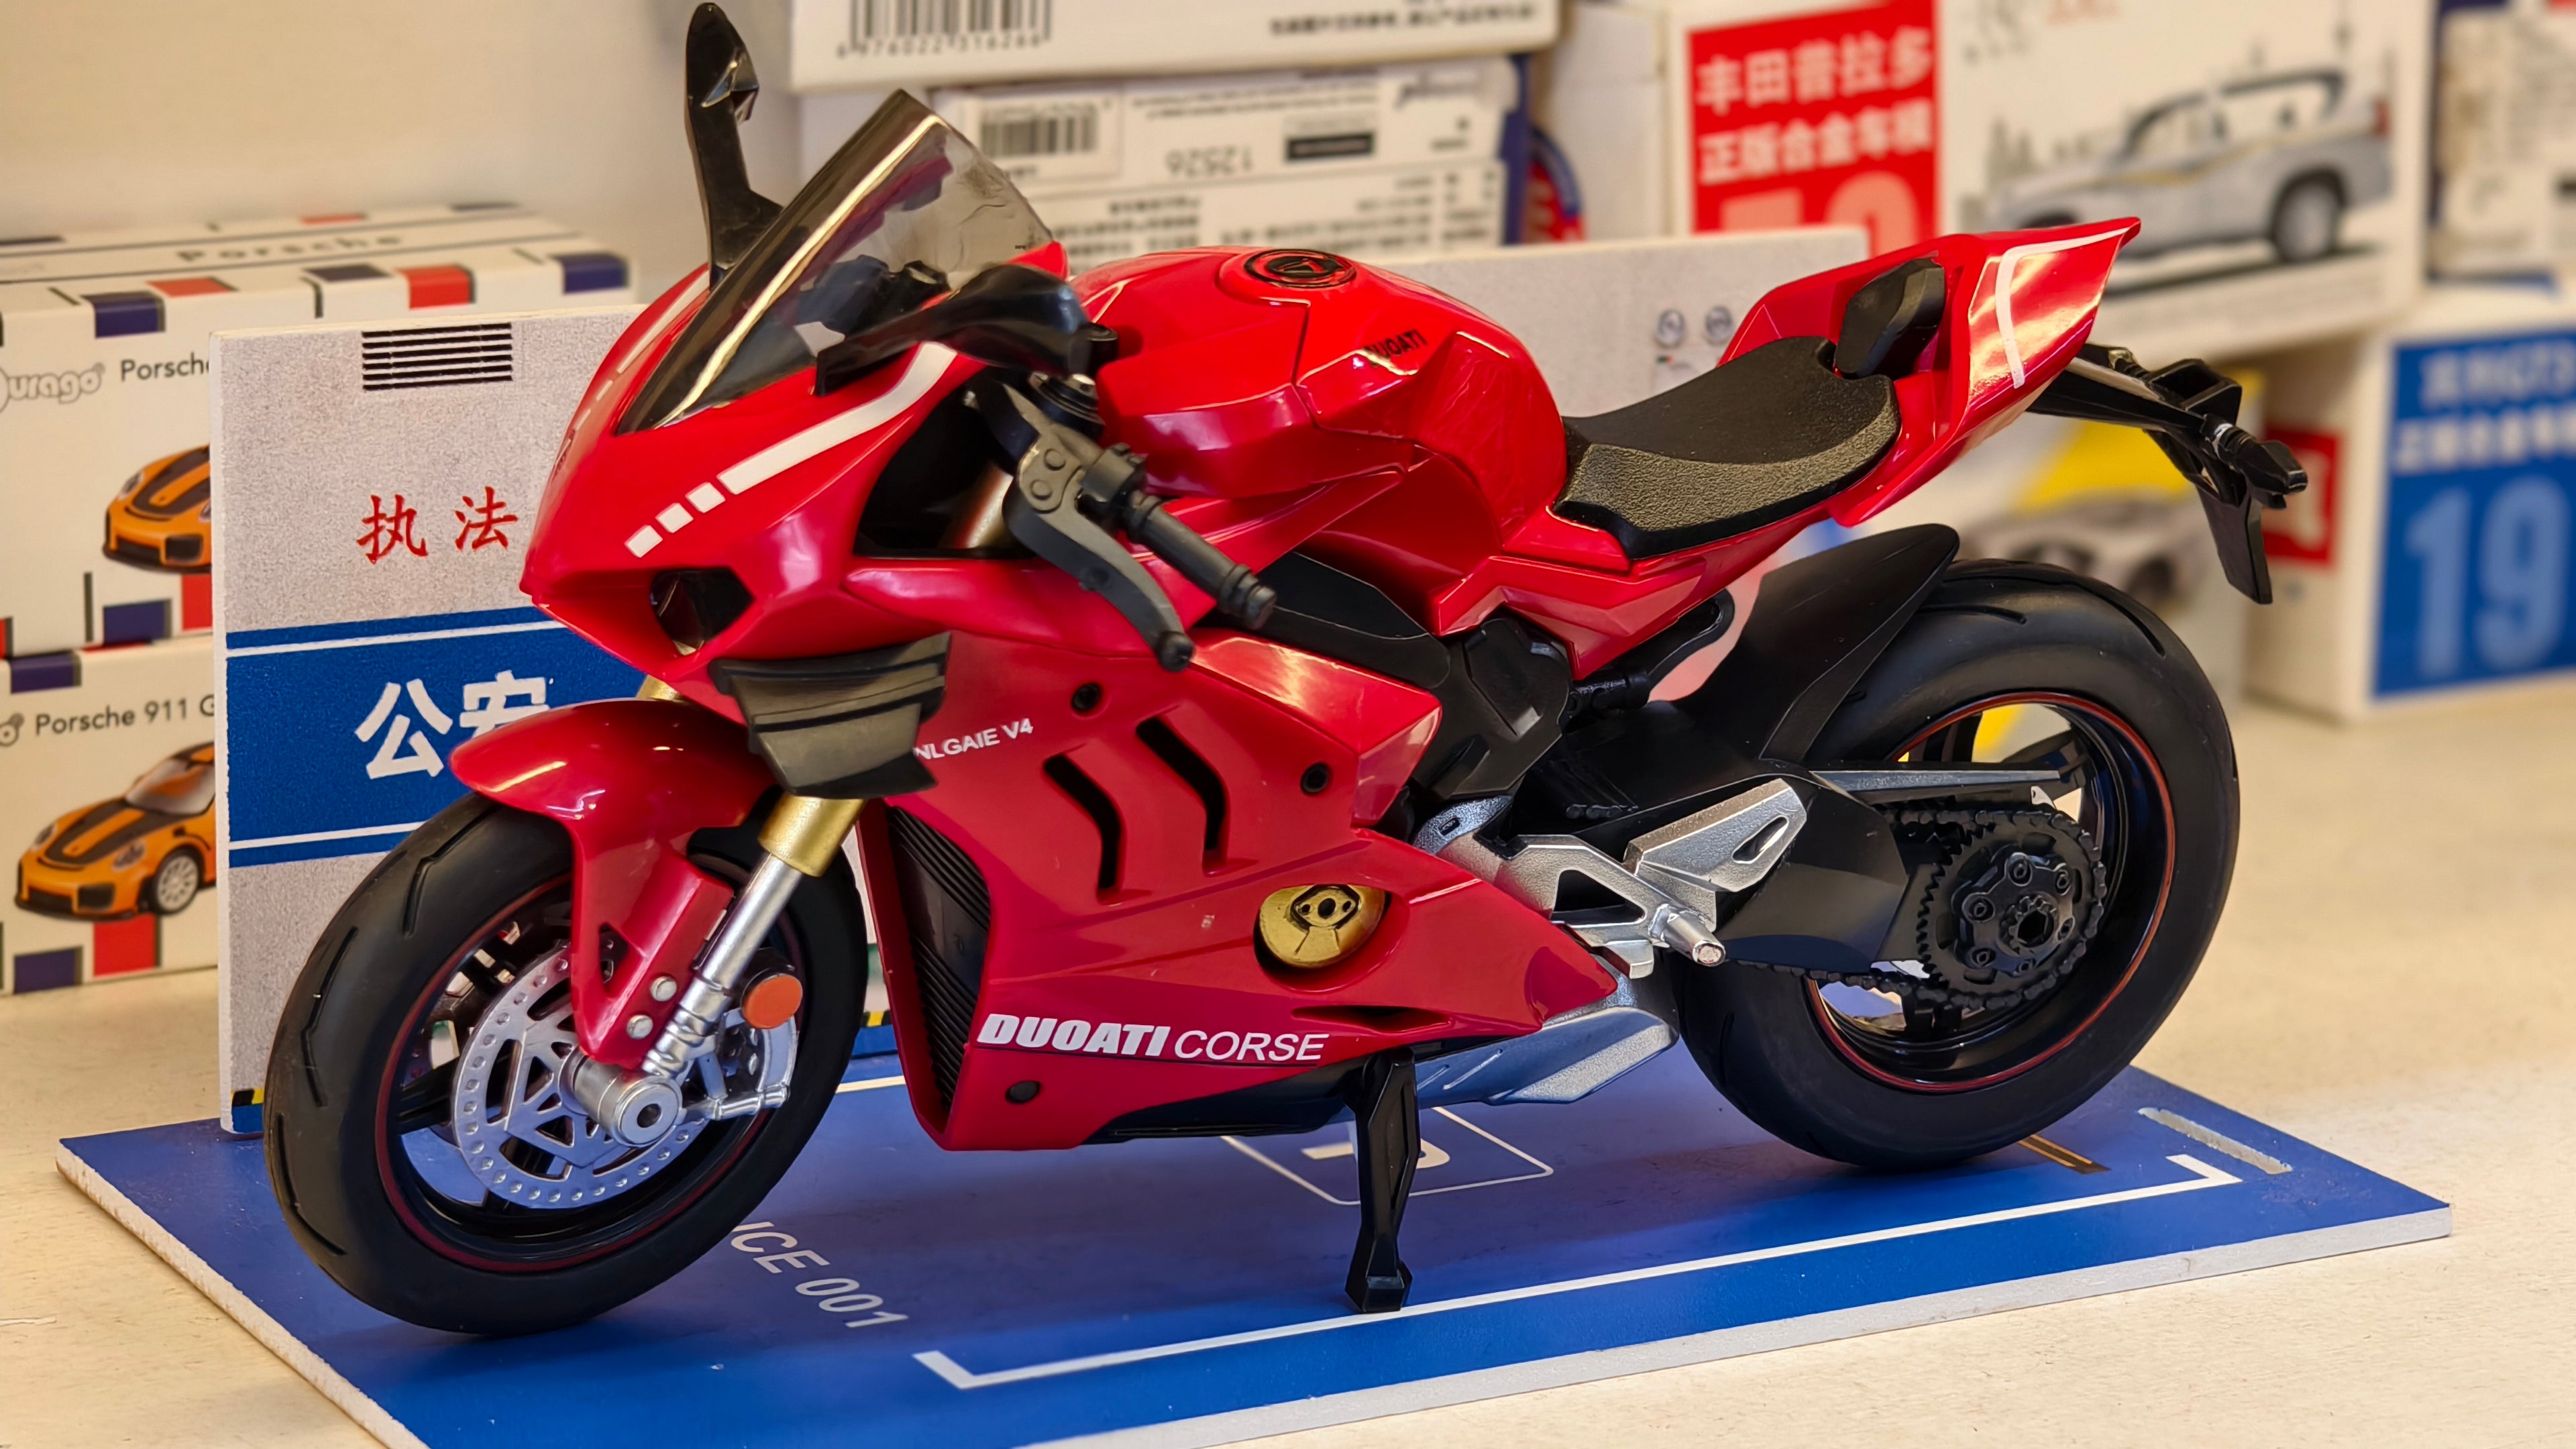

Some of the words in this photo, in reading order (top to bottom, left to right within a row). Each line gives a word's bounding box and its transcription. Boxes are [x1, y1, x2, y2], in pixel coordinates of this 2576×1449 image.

[1697, 25, 1932, 116] 丰田普拉多
[120, 352, 209, 382] Porsch
[356, 485, 519, 564] 执法
[36, 704, 136, 736] Porsche
[144, 698, 187, 723] 911
[1001, 718, 1034, 740] V4
[977, 1013, 1171, 1057] DUOATI
[1173, 1029, 1330, 1062] CORSE
[794, 1277, 910, 1329] 001
